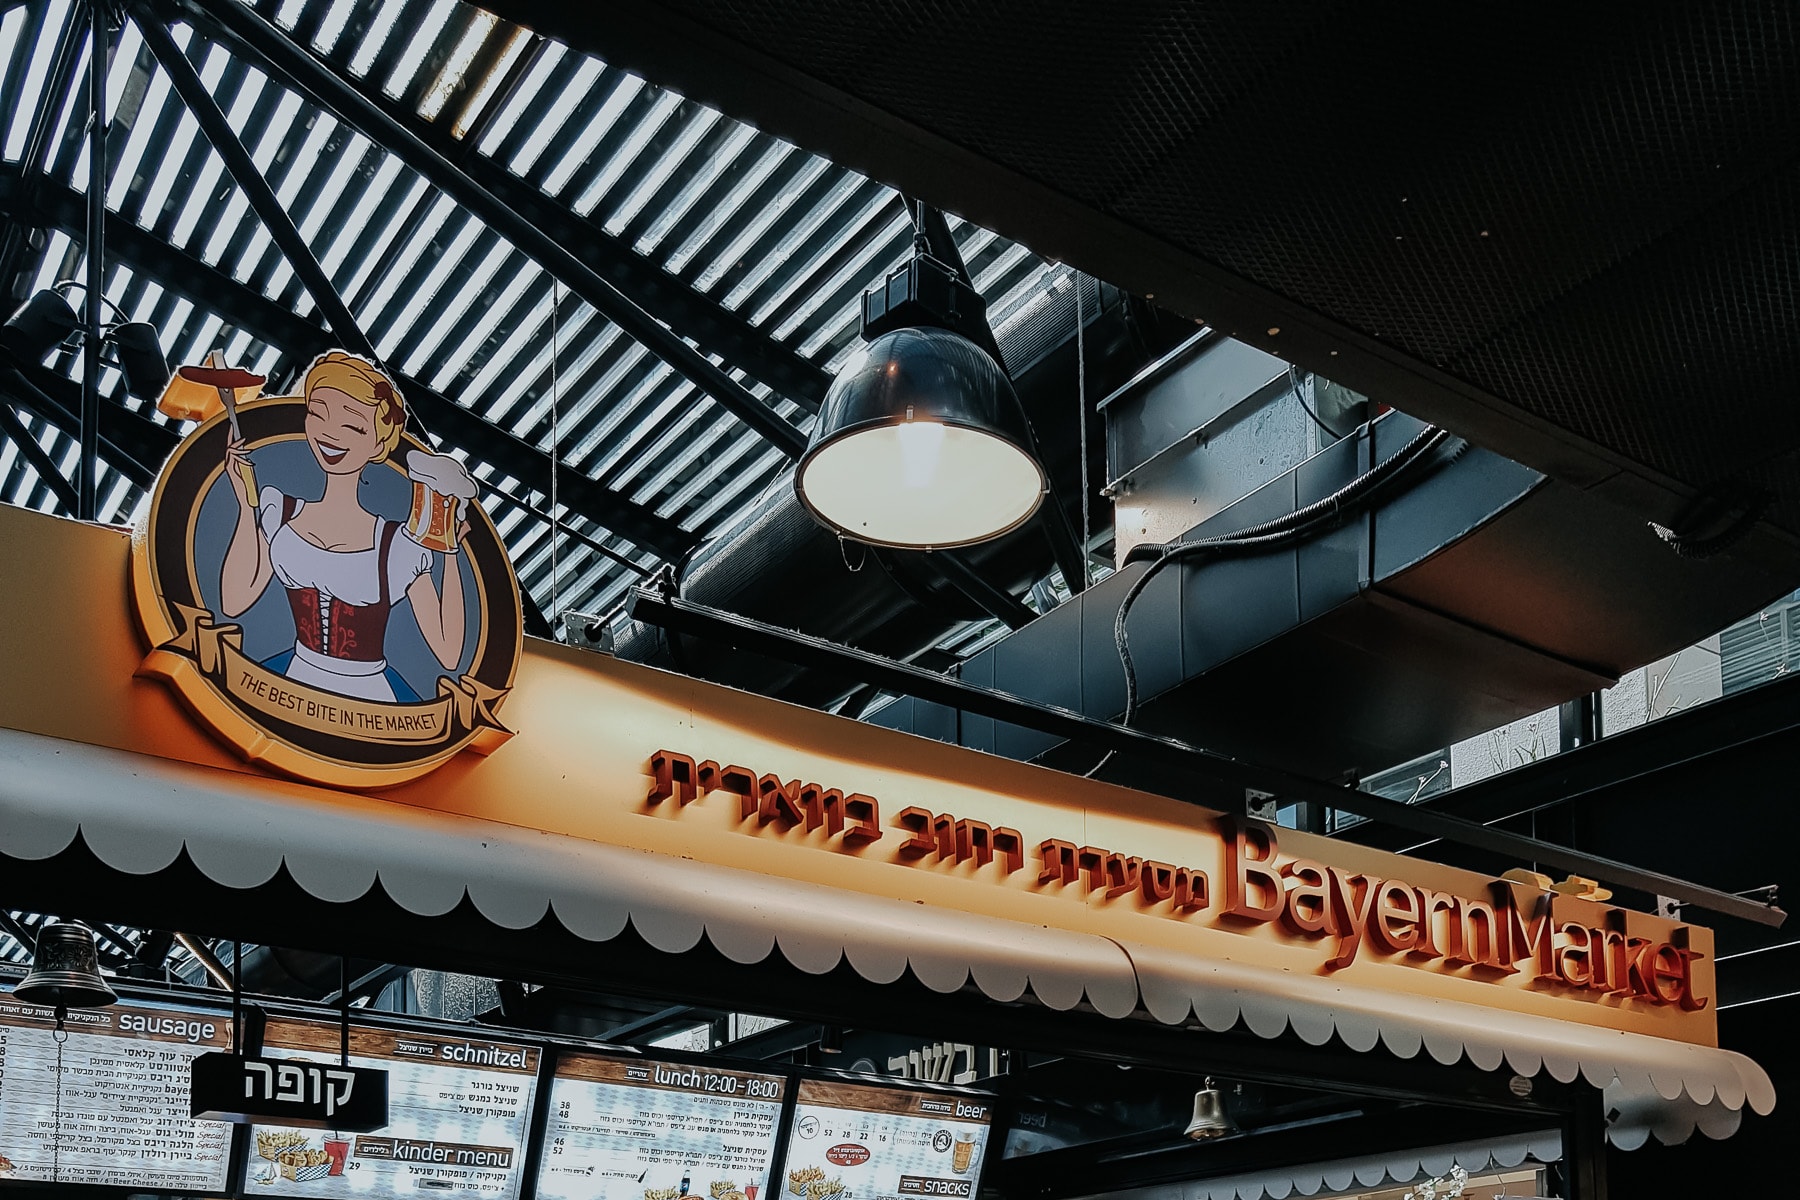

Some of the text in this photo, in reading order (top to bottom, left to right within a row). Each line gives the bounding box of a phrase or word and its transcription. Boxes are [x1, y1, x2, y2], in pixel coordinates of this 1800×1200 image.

[240, 671, 437, 732] THE BEST BITE IN THE MARKET
[647, 749, 1210, 914] מסעדת רחוב בווארית
[1218, 814, 1709, 1012] BayernMarket
[101, 1014, 111, 1023] כל
[119, 1014, 215, 1043] sausage
[124, 1049, 176, 1062] עוף קלאסי
[441, 1043, 528, 1070] schnitzel
[96, 1070, 114, 1078] הבית
[654, 1065, 701, 1088] lunch
[244, 1061, 356, 1117] קופה
[471, 1081, 520, 1093] שניצל בורגר
[494, 1095, 518, 1106] שניצל
[560, 1101, 570, 1110] 38
[955, 1100, 987, 1119] beer
[458, 1105, 516, 1119] פופקורן שניצל
[558, 1110, 569, 1119] 48
[198, 1120, 227, 1129] Special
[197, 1131, 224, 1140] Special
[824, 1129, 833, 1137] 52
[842, 1131, 851, 1139] 28
[859, 1132, 869, 1140] 22
[554, 1137, 565, 1146] 46
[879, 1134, 887, 1142] 16
[196, 1141, 223, 1150] Special
[723, 1144, 743, 1153] שניצל
[392, 1140, 509, 1167] kinder menu
[552, 1146, 563, 1155] 52
[194, 1153, 222, 1162] Special
[349, 1162, 360, 1170] 29
[409, 1165, 434, 1176] שניצל
[436, 1169, 467, 1179] פופקורן
[924, 1180, 969, 1195] snacks
[844, 1191, 852, 1199] 28
